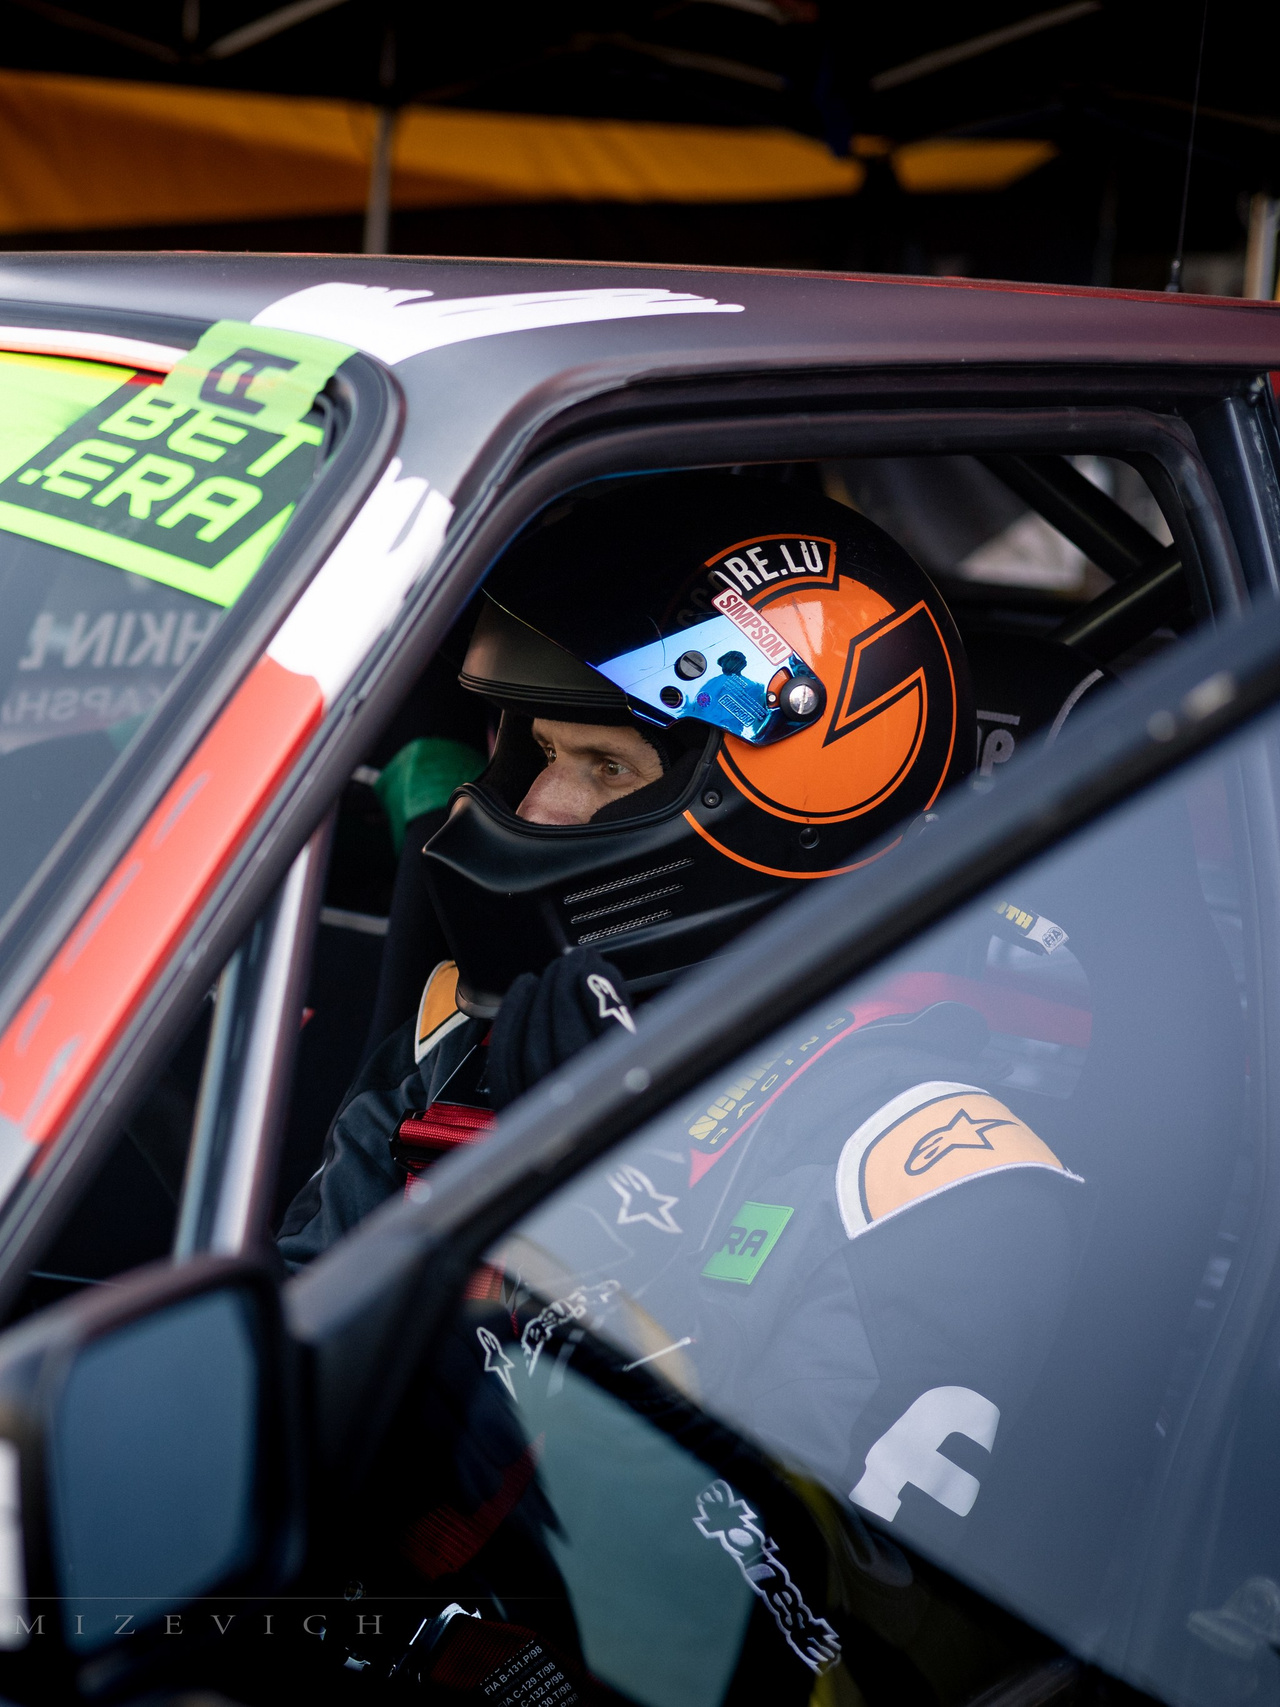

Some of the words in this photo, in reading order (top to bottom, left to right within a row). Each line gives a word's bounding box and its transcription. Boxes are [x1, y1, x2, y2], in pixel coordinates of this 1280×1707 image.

[720, 594, 787, 661] SIMPSON
[484, 1681, 501, 1696] FIA
[498, 1645, 543, 1684] B-131.P/98
[512, 1662, 556, 1699] C-129.T/98
